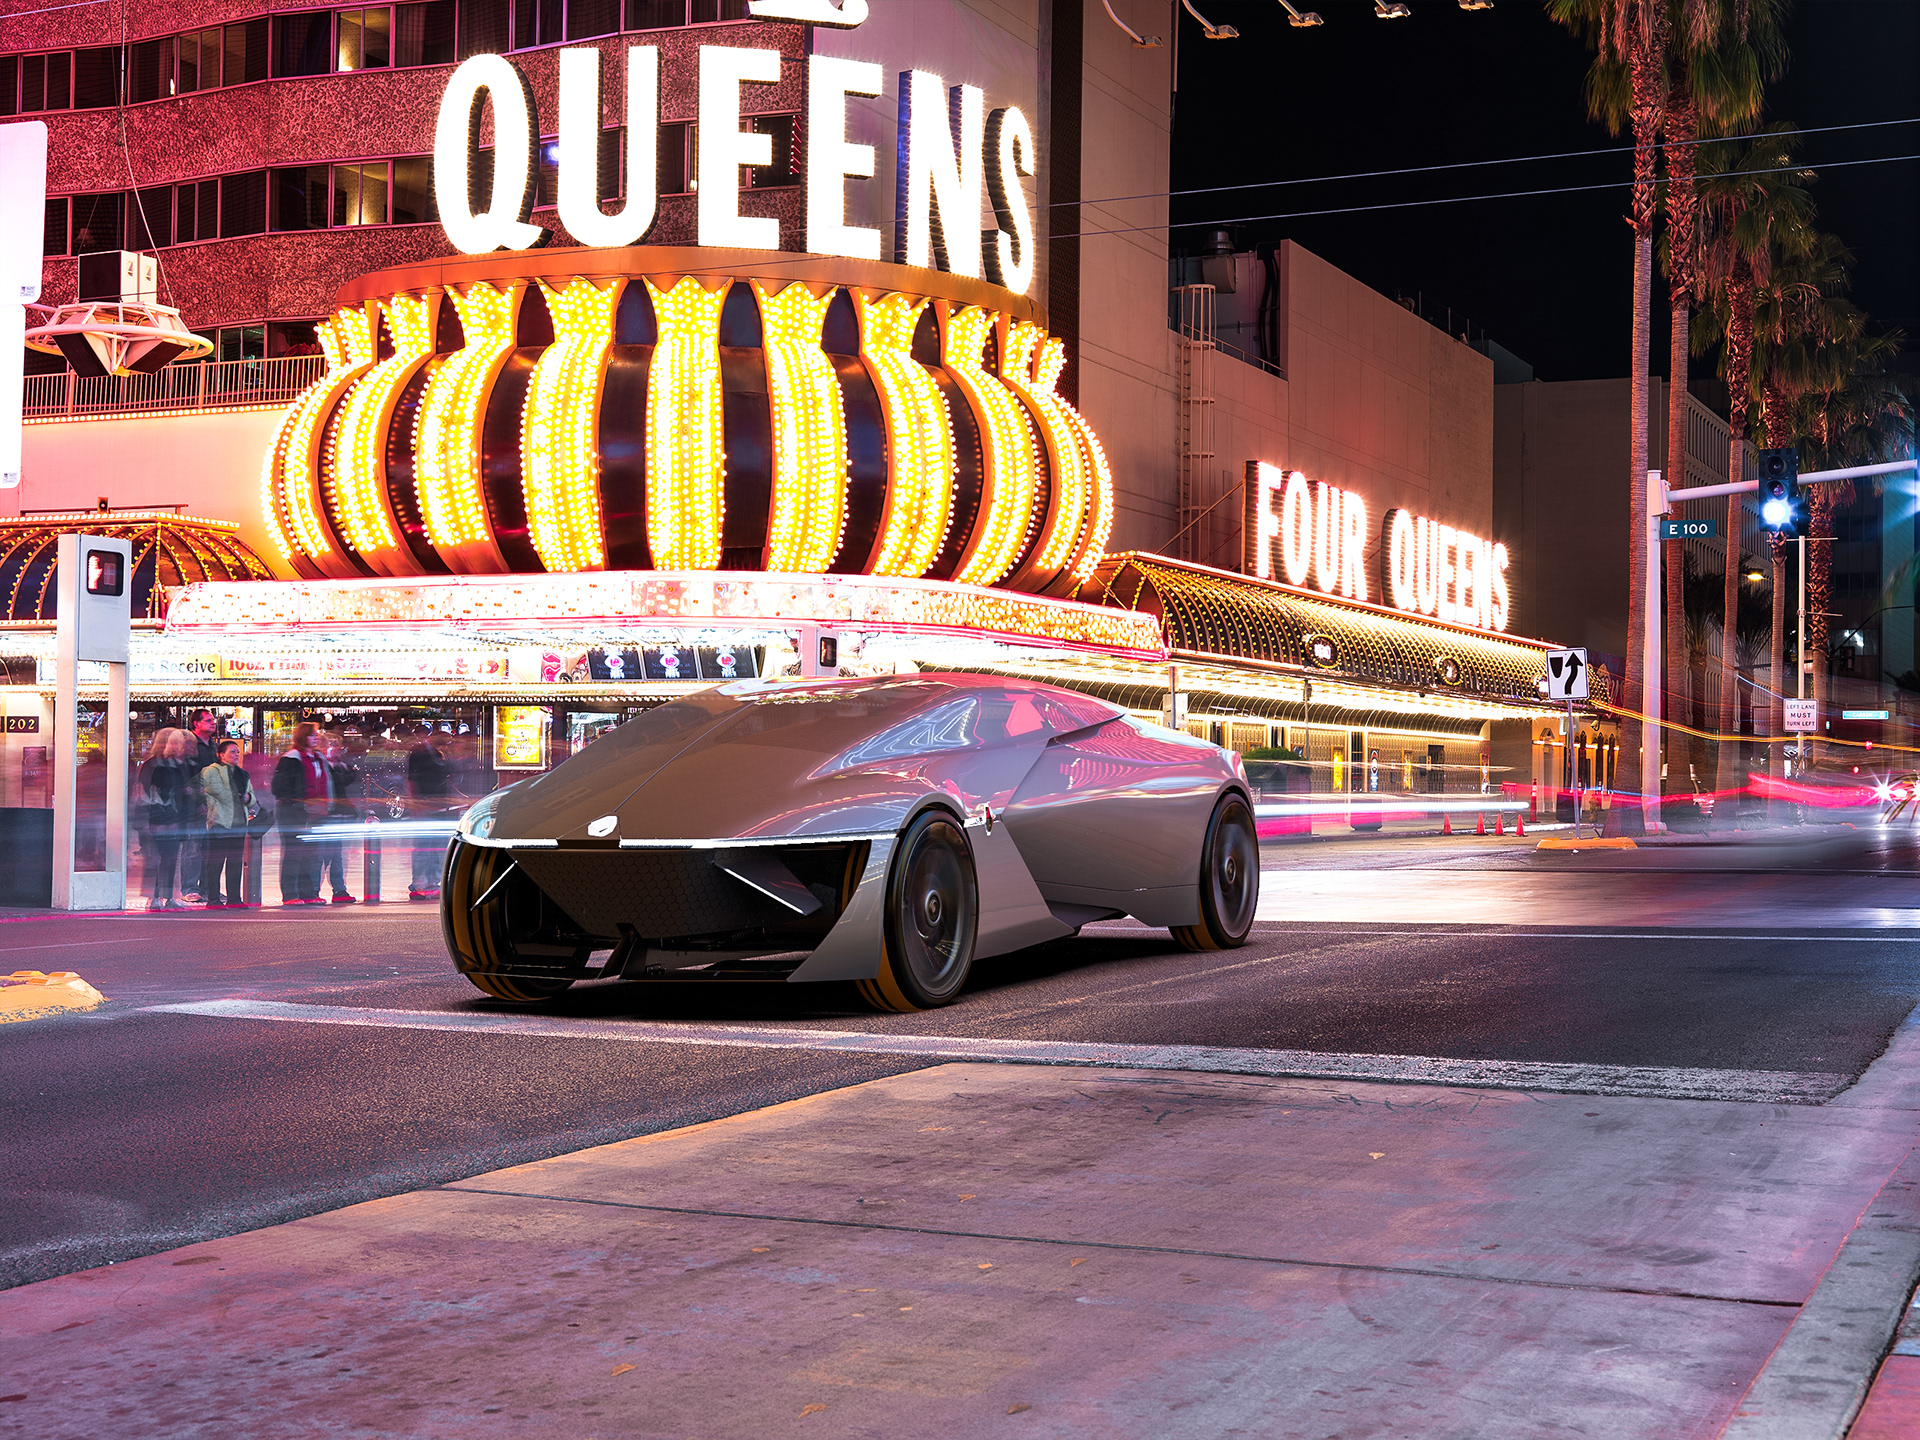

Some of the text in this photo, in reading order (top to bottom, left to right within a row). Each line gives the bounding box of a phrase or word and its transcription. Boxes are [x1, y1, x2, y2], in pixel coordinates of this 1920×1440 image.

[433, 45, 1035, 296] QUEENS
[1669, 523, 1708, 535] E 100
[1250, 461, 1510, 632] FOUR QUEENS
[160, 658, 216, 674] Receive
[9, 718, 35, 730] 202
